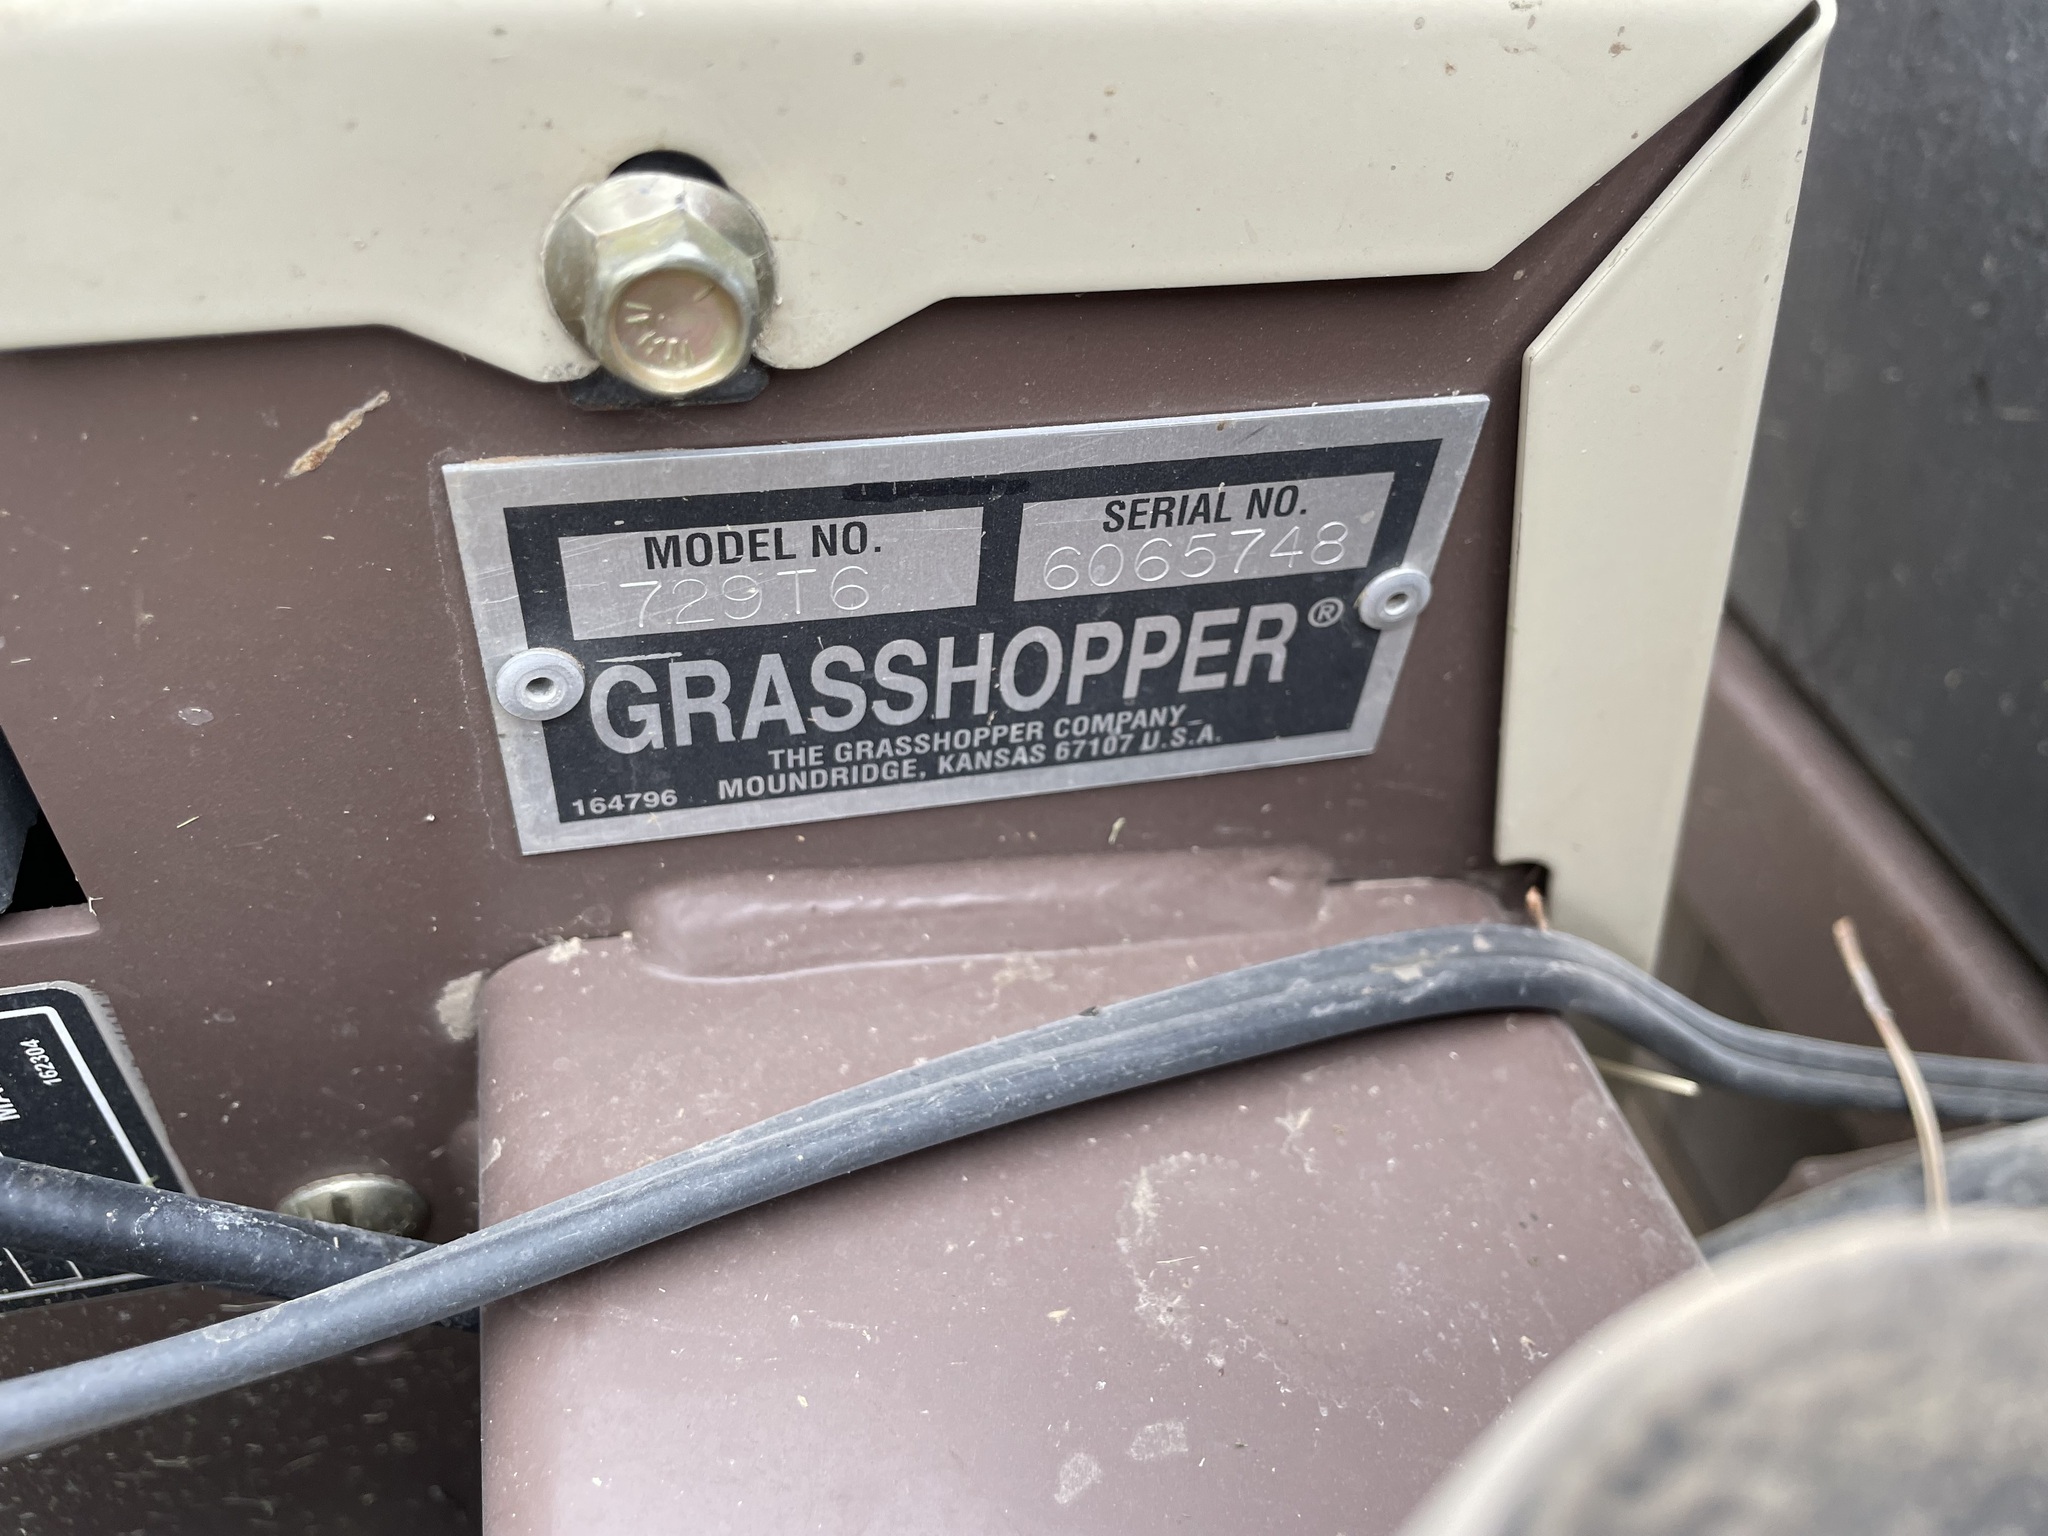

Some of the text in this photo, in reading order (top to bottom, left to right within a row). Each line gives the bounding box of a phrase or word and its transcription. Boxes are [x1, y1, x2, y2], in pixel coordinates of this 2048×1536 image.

[1102, 485, 1308, 533] SERIAL NO.
[644, 521, 882, 570] MODEL NO.
[1042, 521, 1348, 591] 6065748
[619, 565, 870, 628] 729T6
[590, 602, 1298, 754] GRASSHOPPER
[718, 724, 1222, 800] MOUNDRIDGE, KANSAS 67107 U.S.A.
[768, 703, 1188, 770] THE GRASSHOPPER COMPANY
[572, 789, 678, 816] 164796
[20, 1038, 63, 1087] 162304
